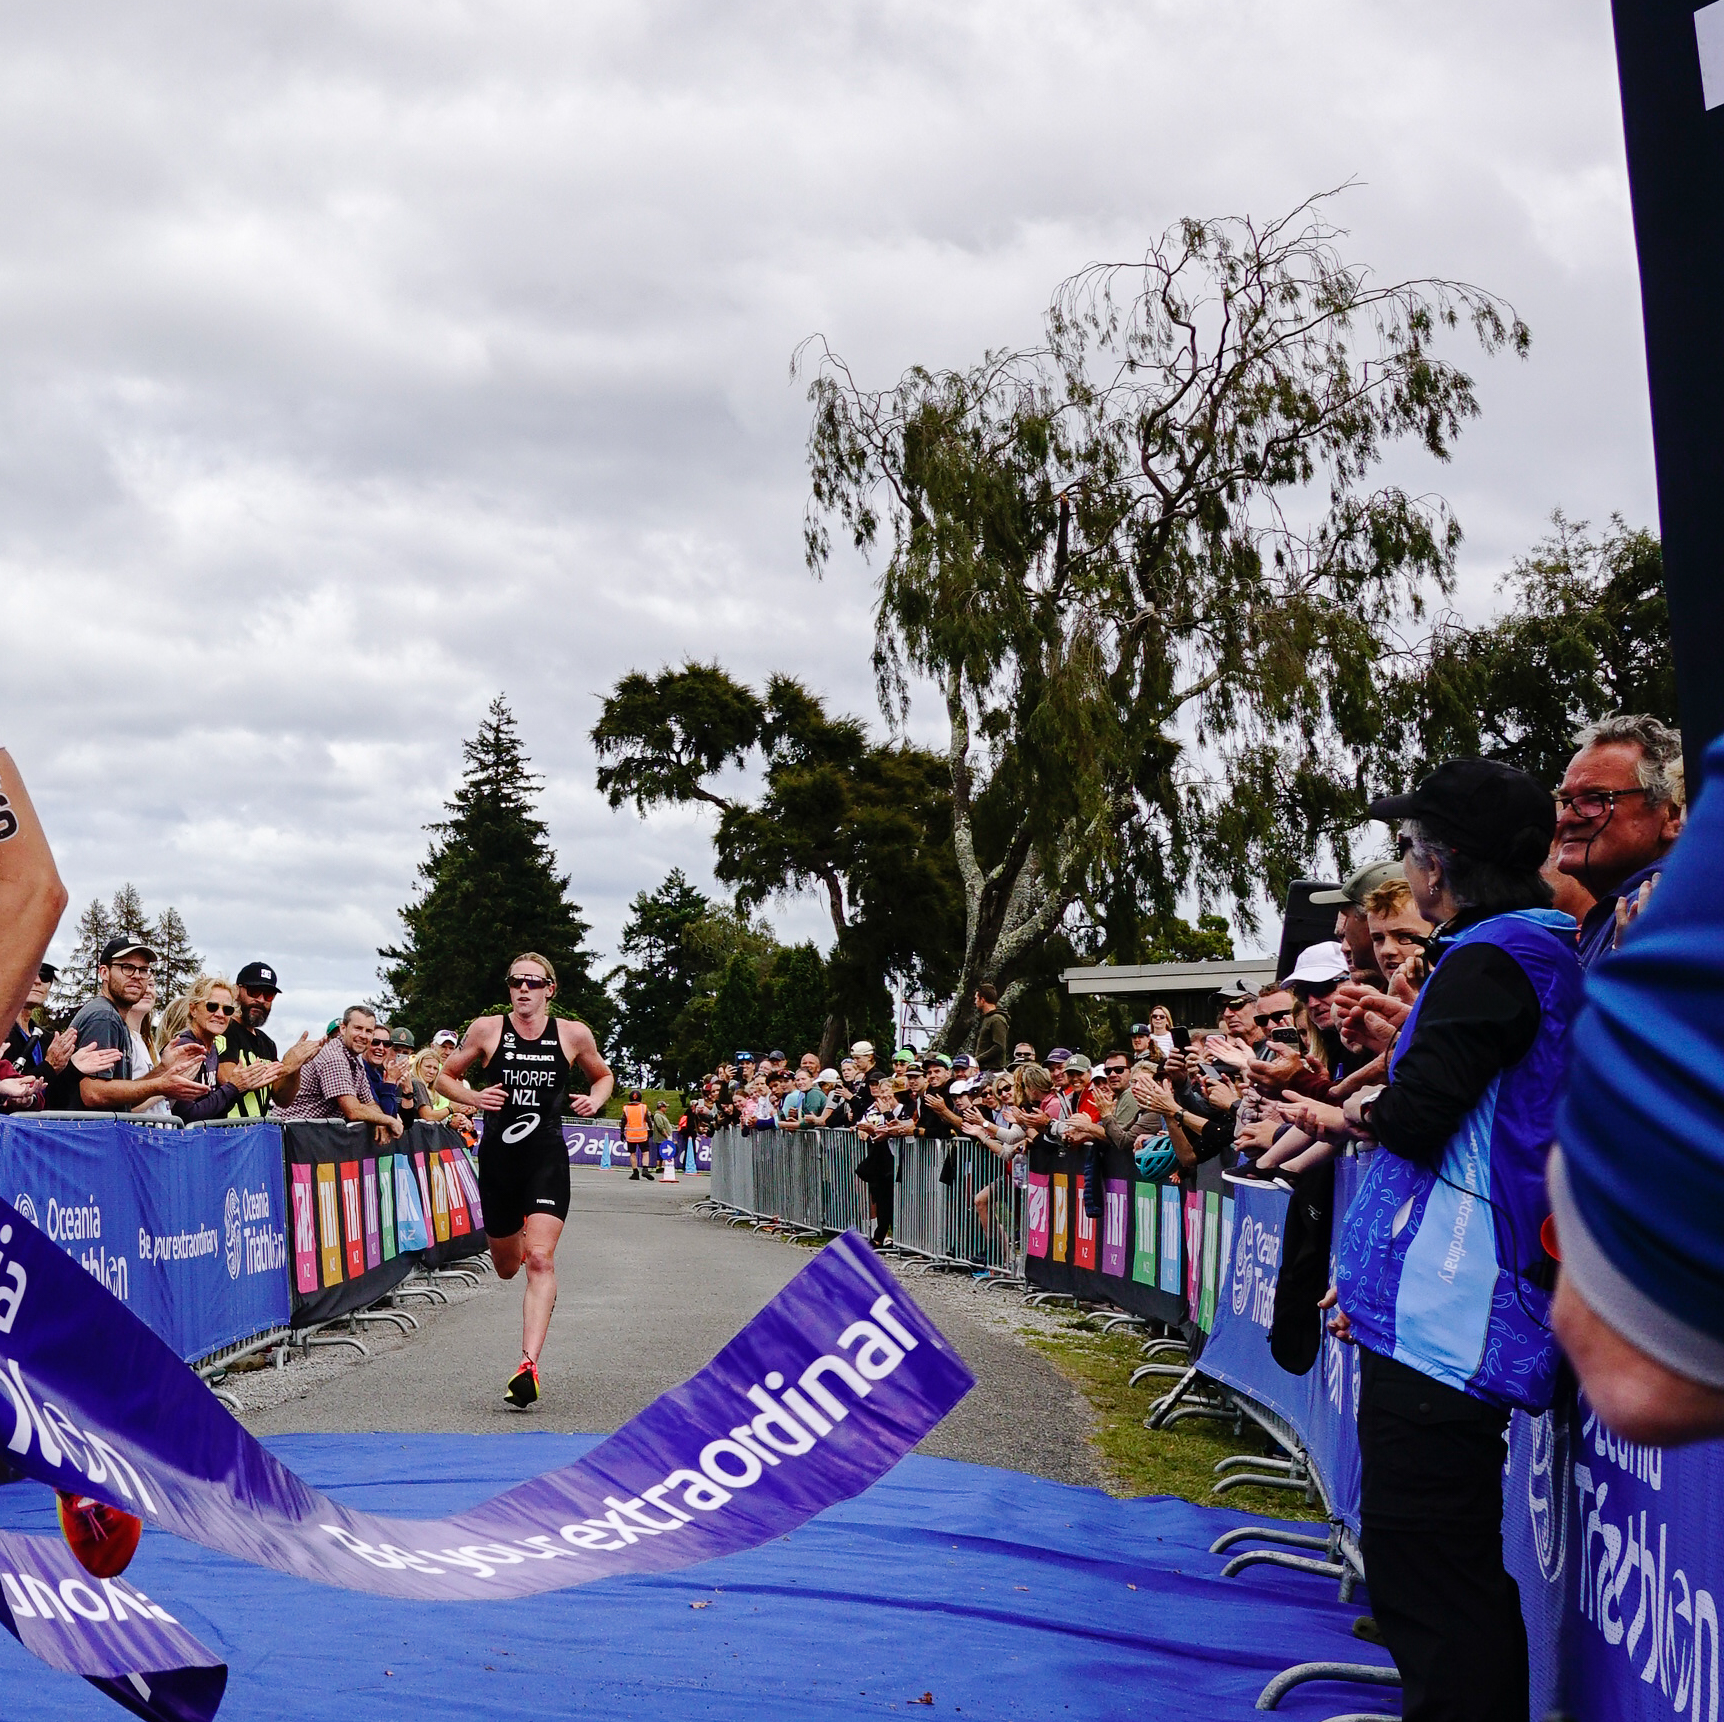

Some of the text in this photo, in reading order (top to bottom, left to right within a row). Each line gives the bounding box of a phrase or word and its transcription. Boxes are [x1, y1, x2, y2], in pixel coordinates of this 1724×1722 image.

[516, 1053, 555, 1062] SUZUKI
[502, 1069, 556, 1088] THORPE
[511, 1089, 541, 1107] NZL
[47, 1194, 101, 1242] Oceania
[242, 1182, 270, 1223] Oceania
[138, 1228, 152, 1260] Be
[243, 1224, 286, 1276] Triathlon
[399, 1229, 416, 1242] NZ
[319, 1293, 920, 1579] Be your extraordinar
